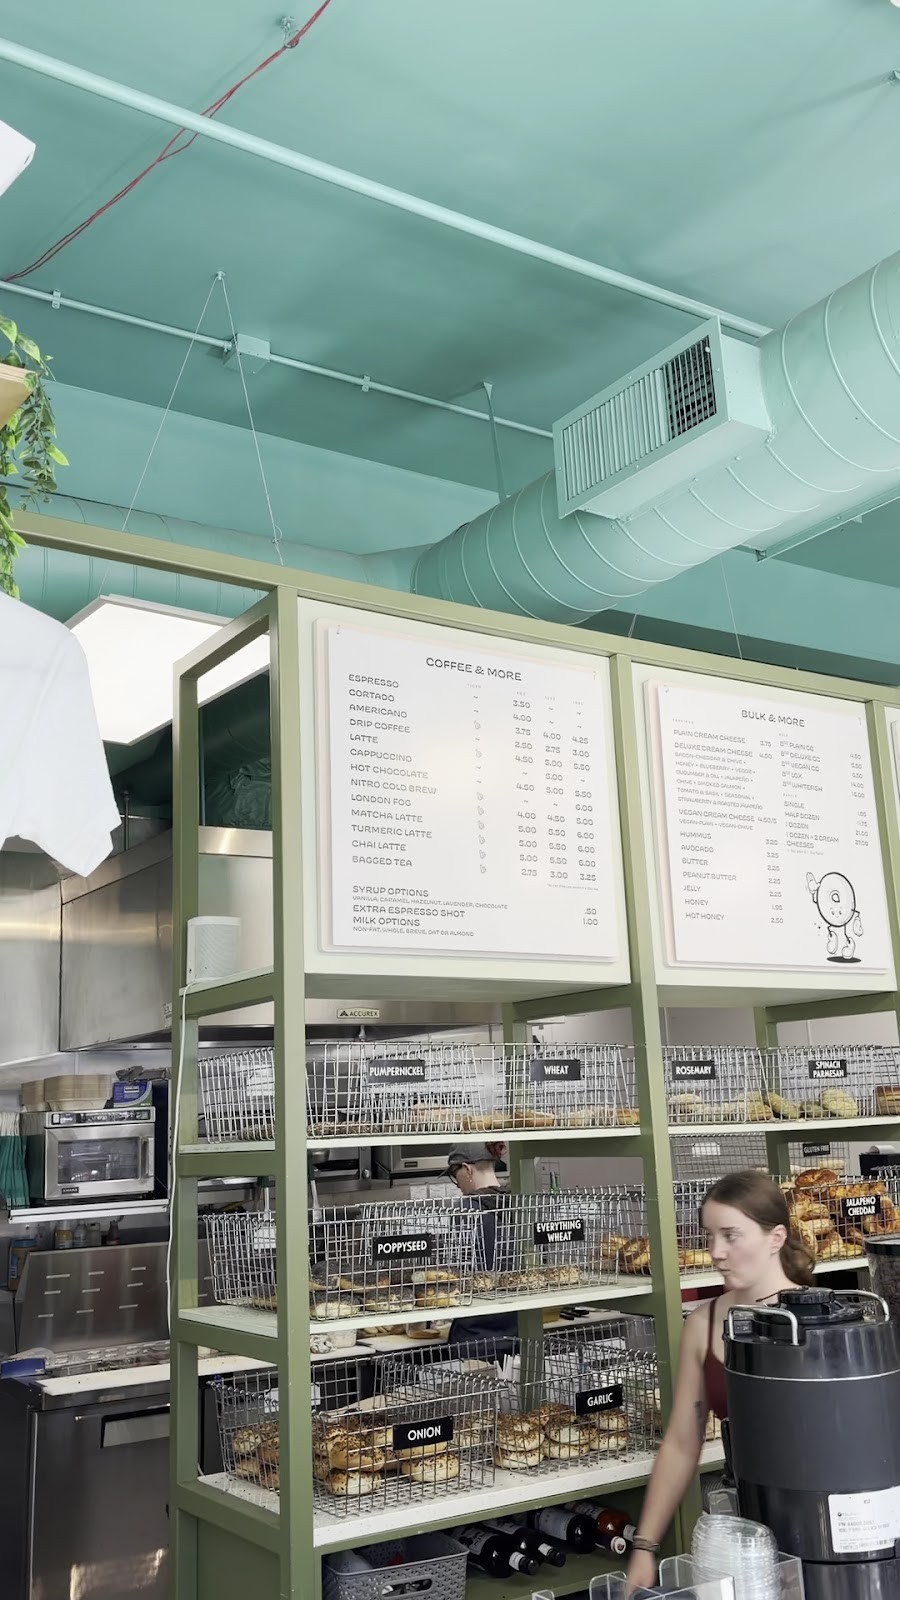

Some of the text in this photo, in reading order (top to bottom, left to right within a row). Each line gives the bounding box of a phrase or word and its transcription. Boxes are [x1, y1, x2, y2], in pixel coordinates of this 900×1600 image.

[426, 658, 522, 681] COFFEE & MORE
[348, 674, 531, 709] ESPRESSO 3.50
[348, 689, 532, 723] CORTADO 4.00
[350, 704, 589, 744] AMERICANO 3.75 4.00 4.25
[742, 710, 805, 727] BULK & MORE
[350, 719, 590, 758] DRIP COFFEE 2.50 2.75 3.00
[674, 729, 693, 737] PLAIN
[694, 732, 718, 740] CREAM
[720, 735, 746, 744] CHEESE
[350, 734, 378, 744] LATTE
[515, 755, 533, 763] 4.50
[545, 760, 563, 768] 5.00
[675, 742, 700, 751] DELUXE
[702, 745, 726, 754] CREAM
[727, 749, 753, 757] CHEESE
[350, 749, 563, 781] CAPPUCCINO 5.00
[351, 764, 370, 772] HOT
[373, 767, 428, 779] CHOCOLATE
[516, 783, 535, 791] 4.50
[546, 787, 564, 795] 5.00
[351, 779, 381, 788] NITRO
[383, 782, 407, 791] COLD
[409, 785, 437, 795] BREW
[351, 794, 391, 805] LONDON
[393, 798, 412, 806] FOG
[518, 811, 536, 819] 4.00
[547, 815, 565, 823] 4.50
[679, 809, 755, 822] VEGAN CREAM CHEESE
[352, 809, 393, 819] MATCHA
[395, 814, 423, 823] LATTE
[518, 826, 537, 834] 5.00
[352, 825, 402, 836] TURMERIC
[405, 830, 432, 839] LATTE
[519, 840, 537, 848] 5.00
[680, 831, 712, 840] HUMMUS
[352, 840, 376, 848] CHAI
[379, 842, 406, 851] LATTE
[520, 854, 538, 862] 5.00
[681, 845, 714, 853] AVOCADO
[352, 856, 392, 865] BAGGED
[394, 859, 412, 867] TEA
[522, 869, 538, 877] 2.75
[550, 871, 568, 879] 3.00
[682, 858, 708, 866] BUTTER
[353, 886, 429, 897] SYRUP OPTIONS
[353, 905, 598, 926] EXTRA ESPRESSO SHOT 1.00
[379, 918, 420, 927] OPTIONS
[370, 1066, 424, 1077] PUMPERNICKEL
[544, 1066, 569, 1076] WHEAT
[676, 1066, 712, 1075] ROSEMARY
[816, 1061, 841, 1070] SPINACH
[813, 1069, 844, 1078] PARMESAN
[848, 1206, 876, 1216] CHEDDAR
[537, 1220, 582, 1233] EVERYTHING
[547, 1231, 573, 1243] WHEAT
[378, 1241, 427, 1255] POPPYSEED
[587, 1392, 613, 1407] GARLIC
[407, 1425, 442, 1441] ONION
